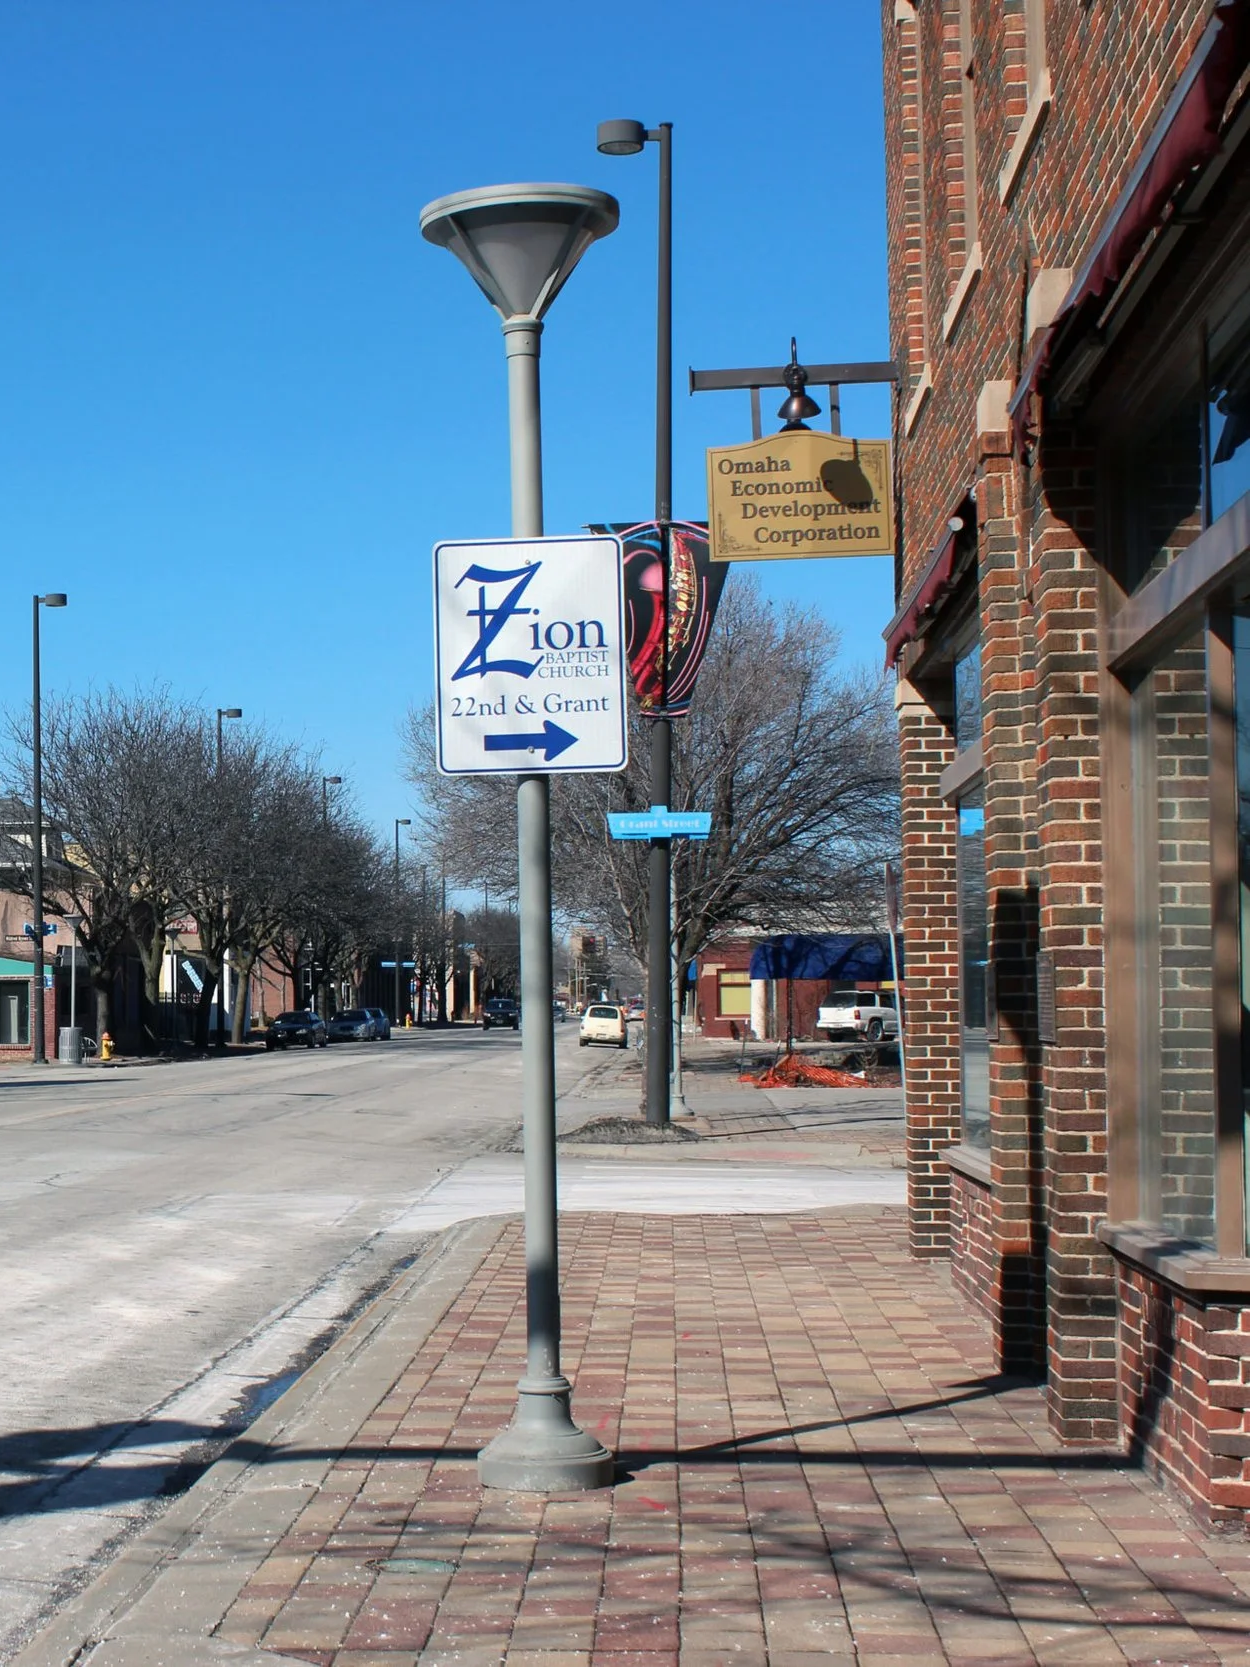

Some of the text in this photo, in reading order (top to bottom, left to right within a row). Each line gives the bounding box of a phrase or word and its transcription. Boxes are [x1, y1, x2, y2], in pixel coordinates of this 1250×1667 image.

[717, 456, 792, 475] Omaha
[730, 476, 835, 497] Economic
[741, 498, 882, 522] Development
[753, 522, 881, 547] Corporation
[451, 561, 609, 682] Zion
[545, 650, 610, 665] BAPTIST
[537, 664, 610, 679] CHURCH
[451, 692, 611, 718] 22nd & Grant
